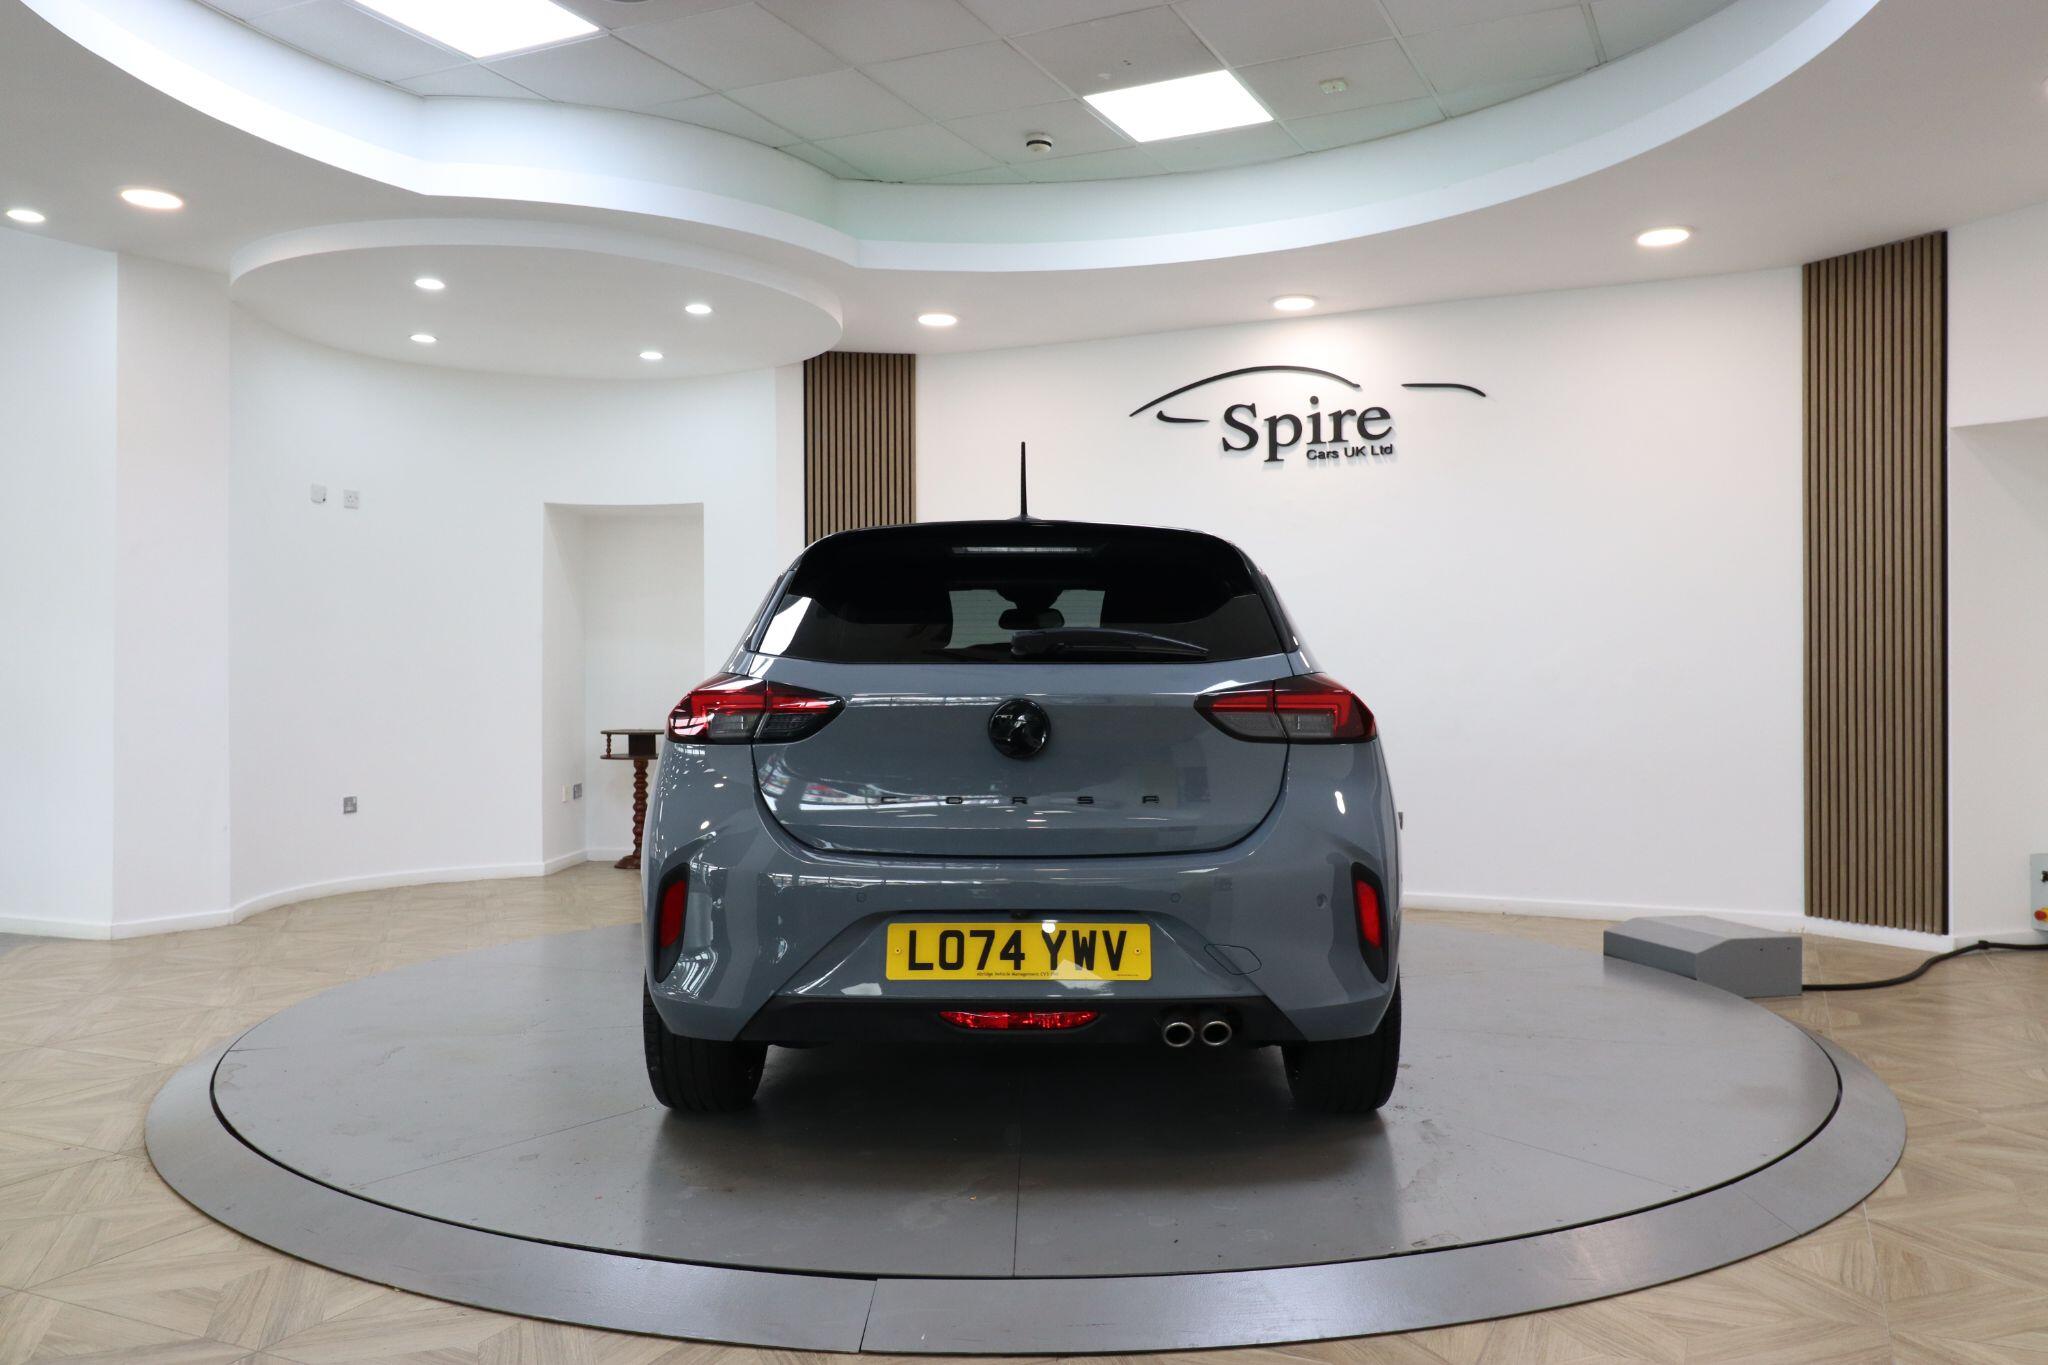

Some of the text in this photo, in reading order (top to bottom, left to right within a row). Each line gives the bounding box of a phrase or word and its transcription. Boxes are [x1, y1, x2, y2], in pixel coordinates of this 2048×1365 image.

[1222, 396, 1392, 463] Spire
[1306, 444, 1393, 461] Cars UK Ltd
[881, 795, 1160, 805] CORSA
[908, 930, 1128, 971] LO74 YWV
